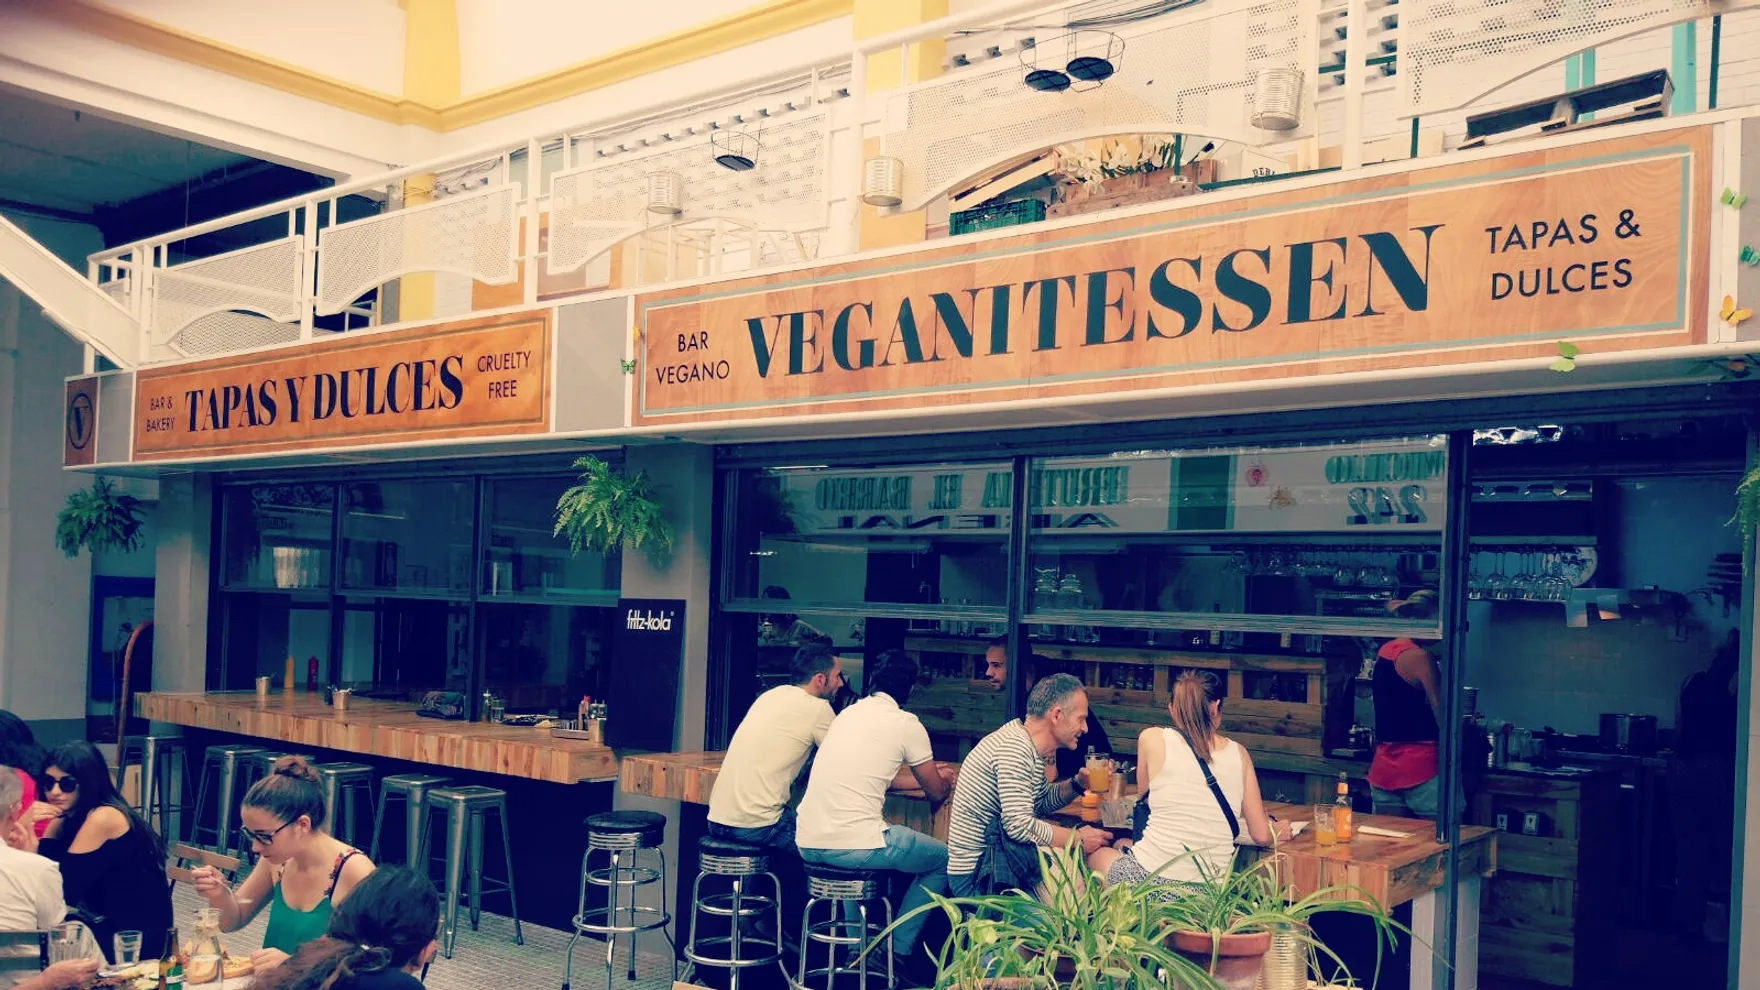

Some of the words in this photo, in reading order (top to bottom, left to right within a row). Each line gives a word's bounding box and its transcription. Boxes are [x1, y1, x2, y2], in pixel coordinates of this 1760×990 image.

[1485, 213, 1598, 254] TAPAS
[1615, 208, 1642, 239] &
[1491, 258, 1633, 300] DULCES
[744, 224, 1446, 378] VEGANITESSEN
[677, 331, 709, 352] BAR
[477, 351, 531, 373] CRUELTY
[655, 360, 730, 386] VEGANO
[185, 378, 277, 433] TAPAS
[285, 375, 304, 423] Y
[311, 355, 464, 421] DULCES
[488, 379, 518, 398] FREE
[150, 397, 165, 411] BAR
[146, 417, 175, 432] BAKERY
[627, 609, 671, 630] fritz-kola
